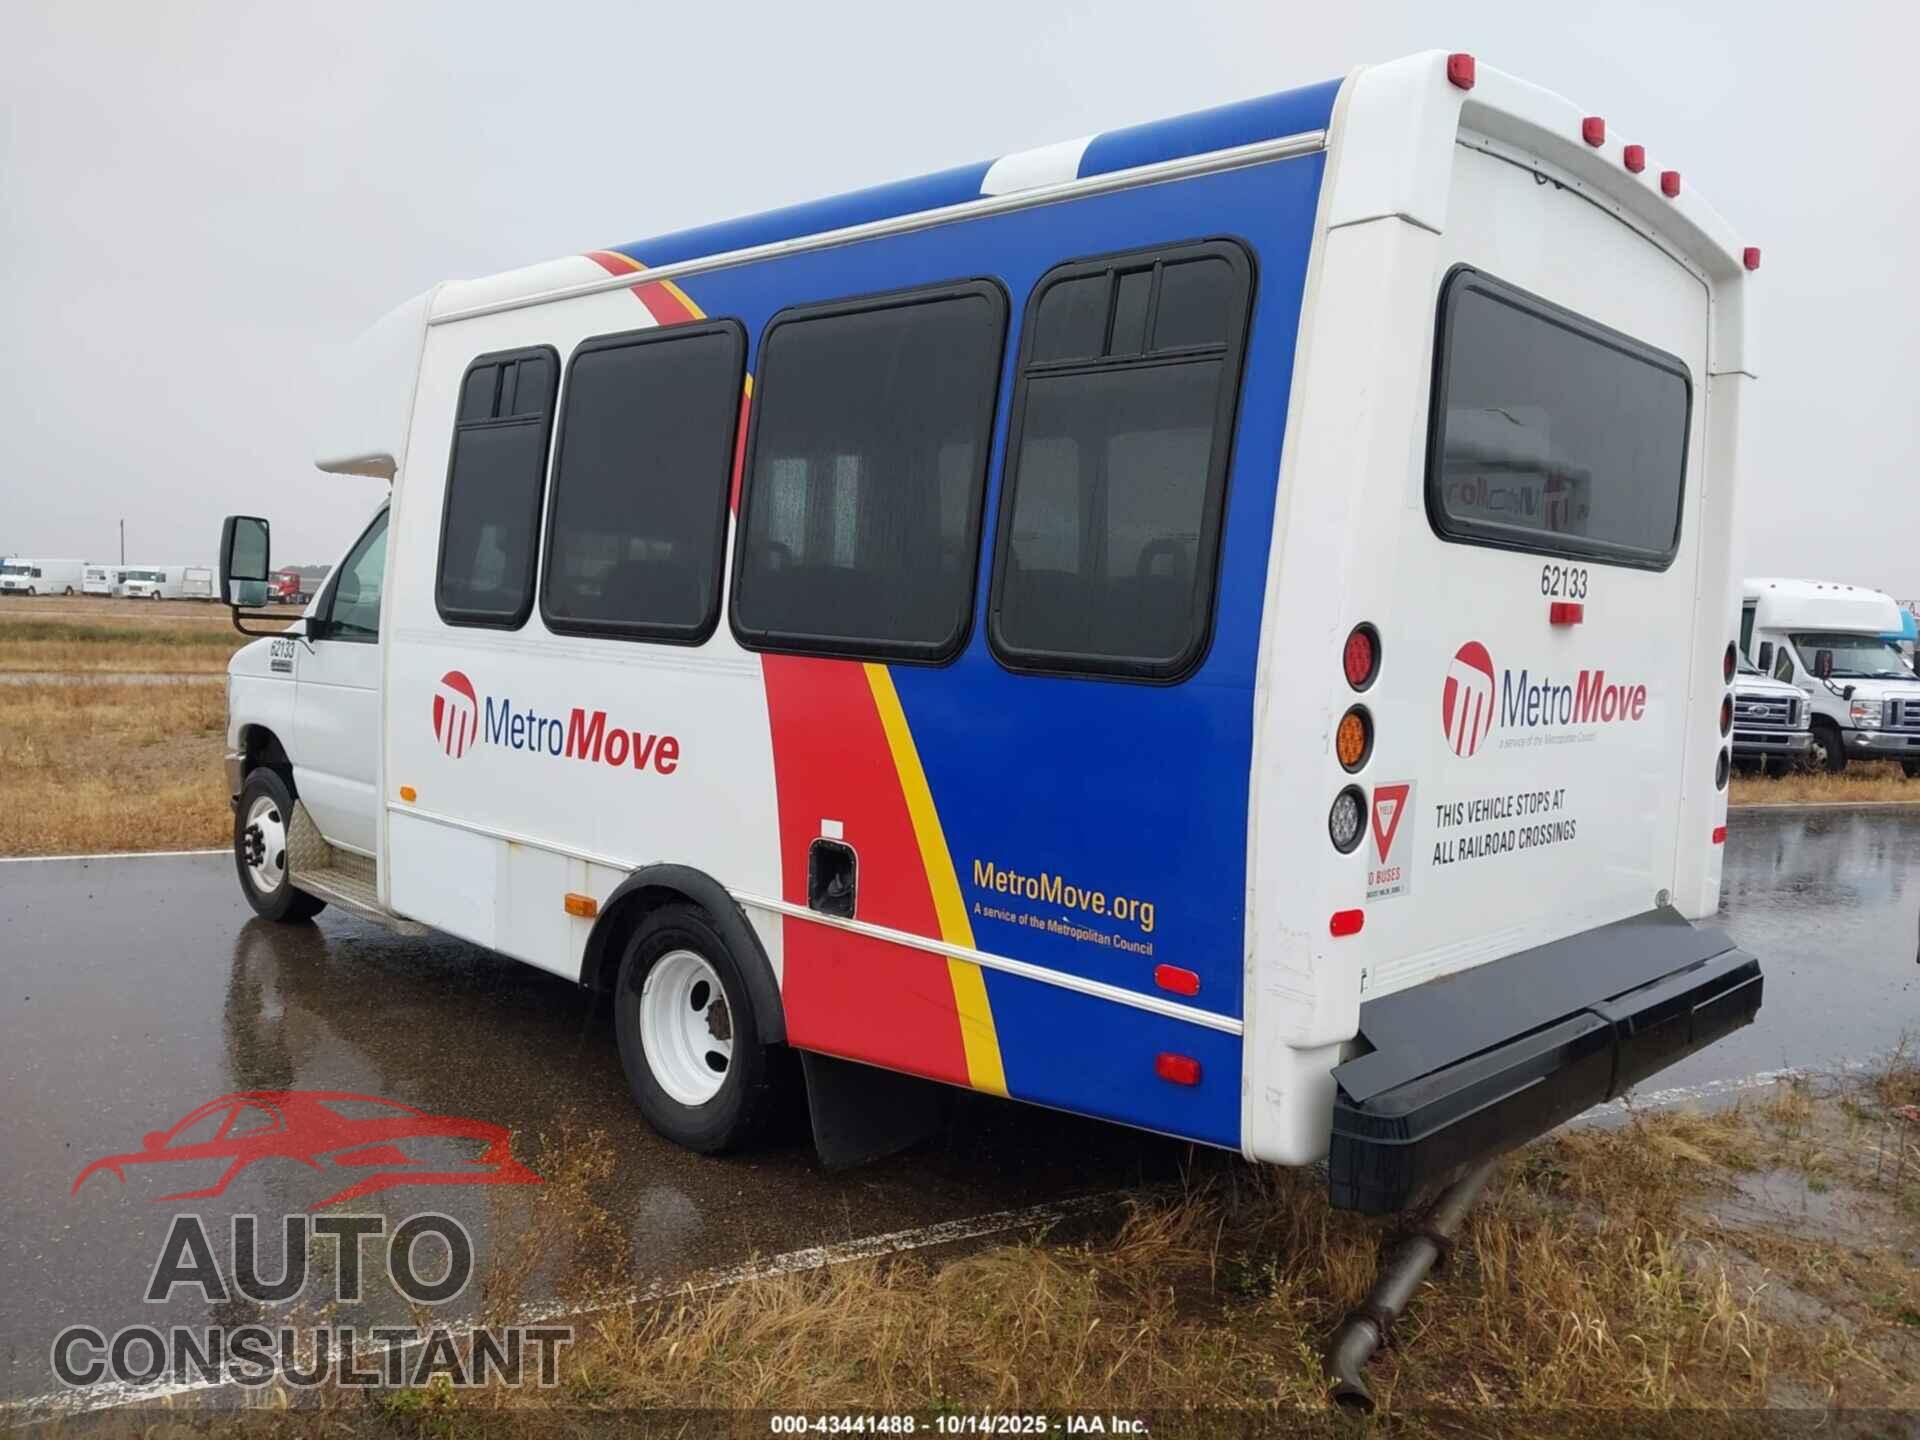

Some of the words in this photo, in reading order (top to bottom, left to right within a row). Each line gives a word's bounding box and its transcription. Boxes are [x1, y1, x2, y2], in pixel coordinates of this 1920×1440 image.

[1541, 564, 1588, 599] 62133
[1500, 669, 1647, 728] MetroMove
[484, 696, 680, 775] MetroMove
[1436, 803, 1464, 828] THIS
[1468, 795, 1513, 823] VEHICLE
[1516, 791, 1550, 816] STOPS
[1552, 789, 1565, 810] AT
[1432, 840, 1455, 866] ALL
[1458, 830, 1515, 861] RAILROAD
[1518, 819, 1577, 849] CROSSINGS
[973, 859, 1155, 933] MetroMove.org
[1376, 866, 1401, 884] BUSES
[974, 902, 982, 914] A
[983, 906, 1017, 923] service
[1018, 913, 1029, 925] of
[1029, 915, 1045, 930] the
[1047, 919, 1111, 946] Metropolitan
[1113, 934, 1153, 956] Council
